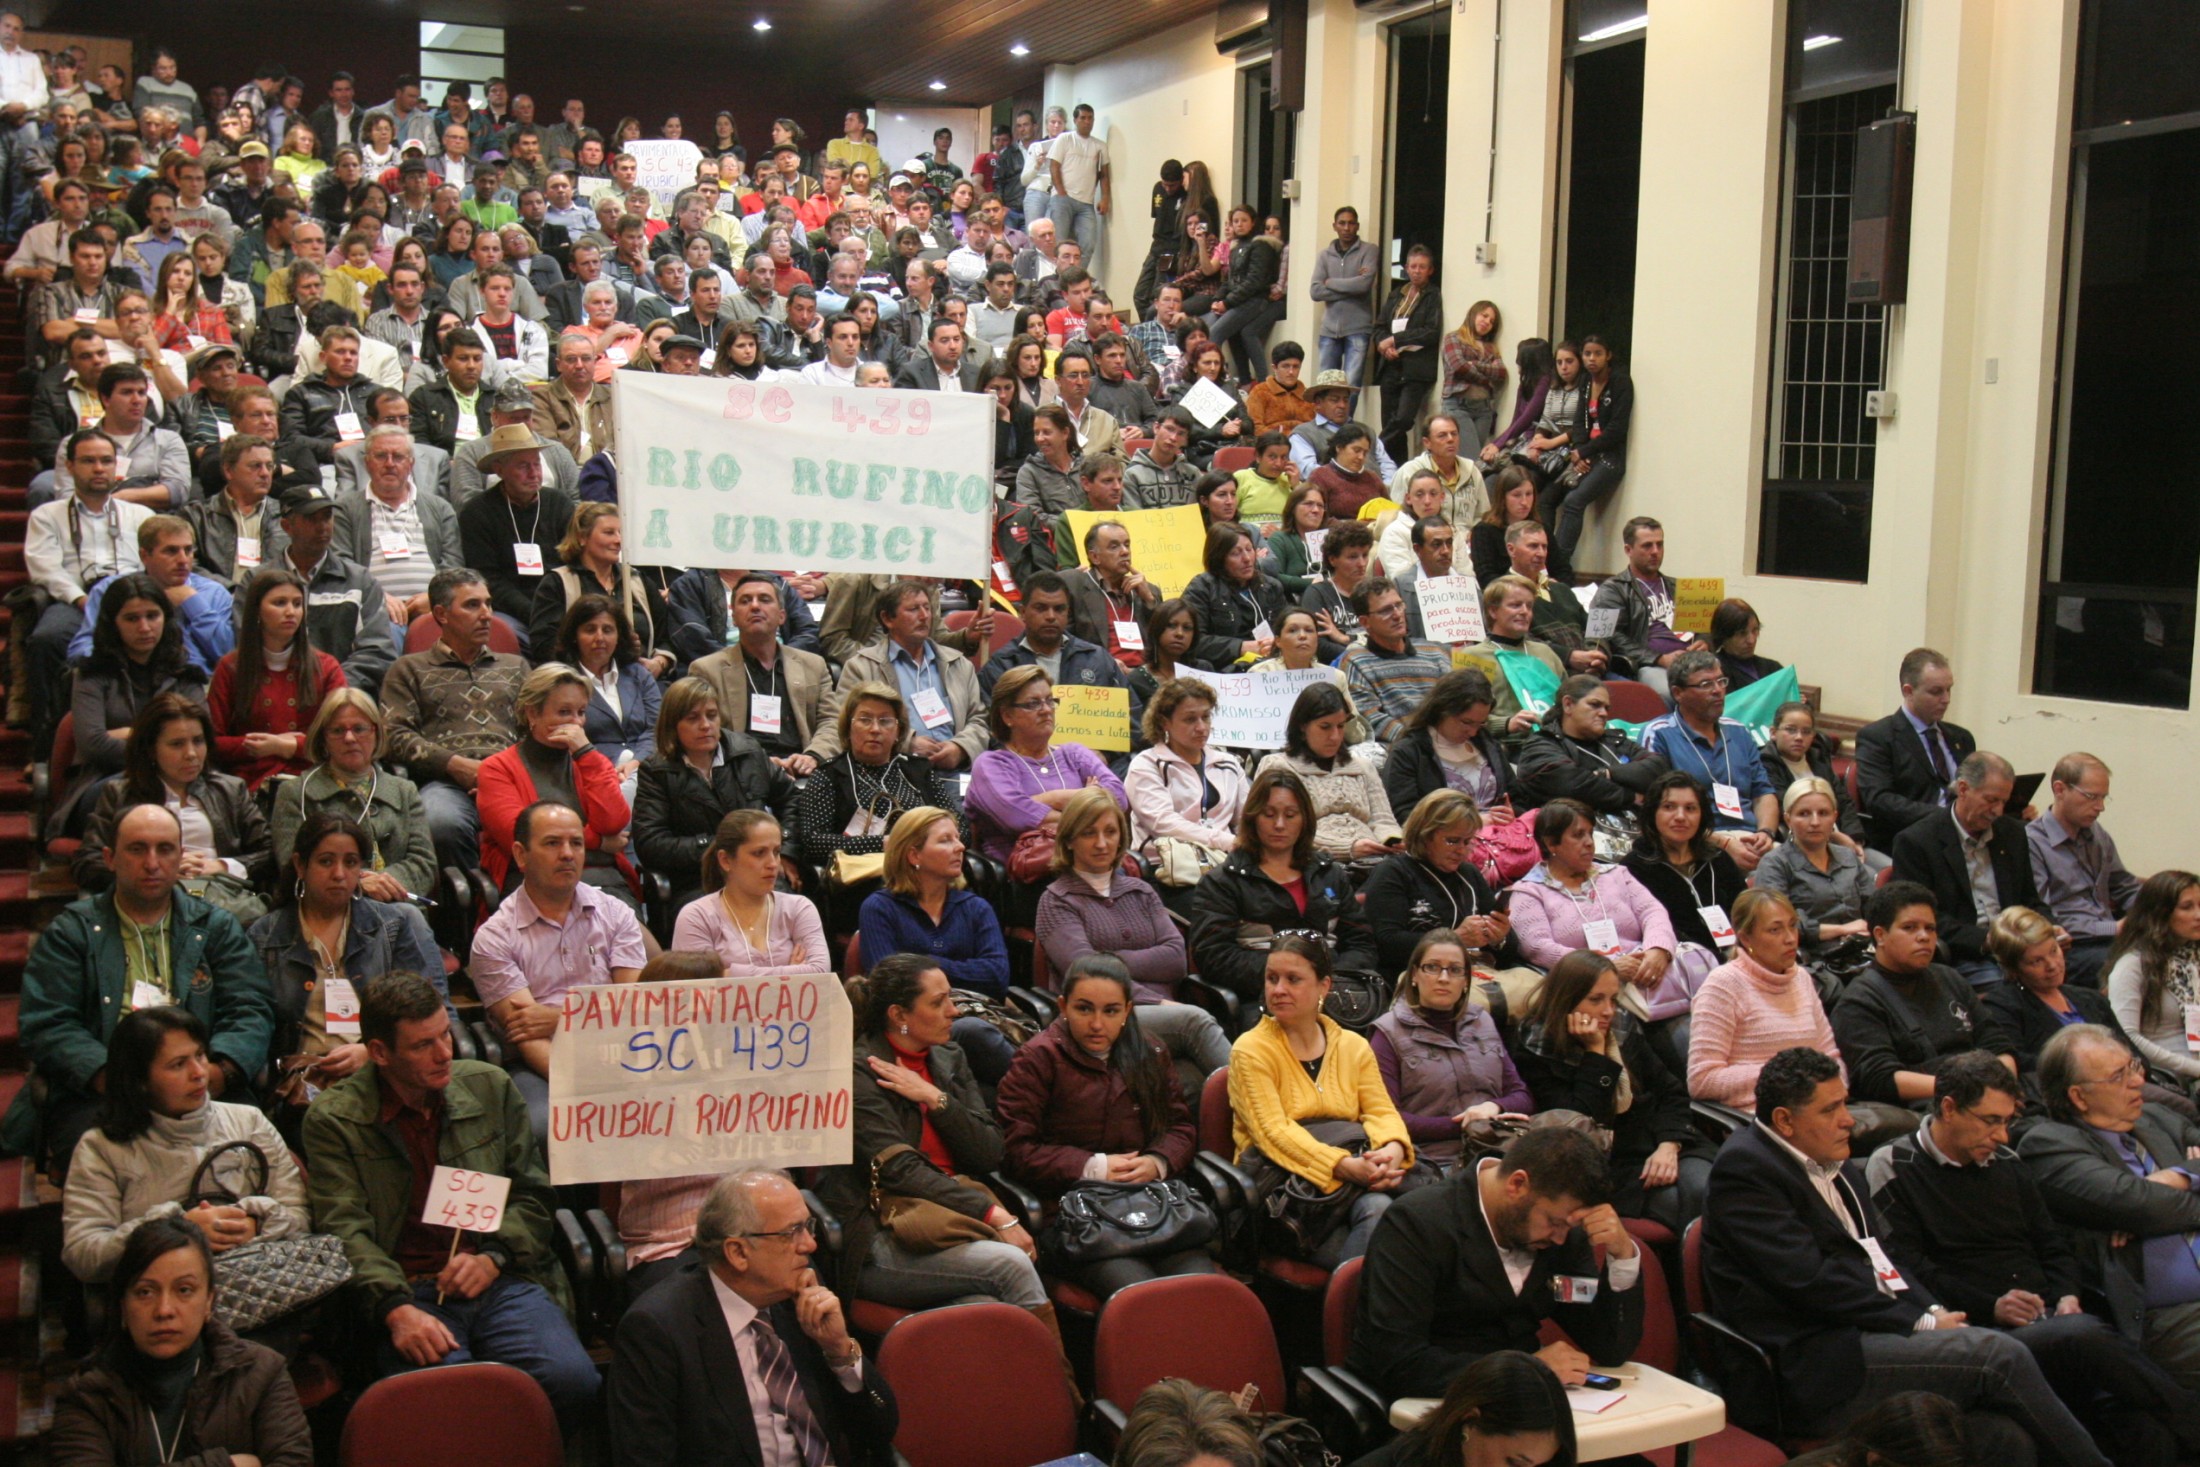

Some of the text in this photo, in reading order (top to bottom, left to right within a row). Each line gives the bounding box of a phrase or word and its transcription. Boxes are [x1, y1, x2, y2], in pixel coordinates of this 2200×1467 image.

[642, 157, 694, 172] SC 43
[723, 383, 932, 436] SC 439
[646, 446, 991, 514] RIO RUFINO
[642, 508, 938, 564] A URUBICI
[1419, 577, 1468, 592] SC 439
[1427, 608, 1450, 620] para
[1591, 609, 1610, 621] SC
[1593, 623, 1613, 637] 439
[1261, 669, 1326, 684] Rio Rufino
[1056, 686, 1110, 701] SC 439
[1220, 677, 1252, 696] 439
[1265, 683, 1300, 696] Urub
[1213, 705, 1281, 719] PROMISSO
[1109, 725, 1130, 738] luta
[1212, 728, 1246, 741] ERNO
[562, 976, 818, 1032] PAVIMENTAÇÃO
[620, 1022, 811, 1073] SC 439
[553, 1096, 676, 1143] URUBICI
[447, 1169, 485, 1193] SC
[441, 1199, 498, 1231] 439
